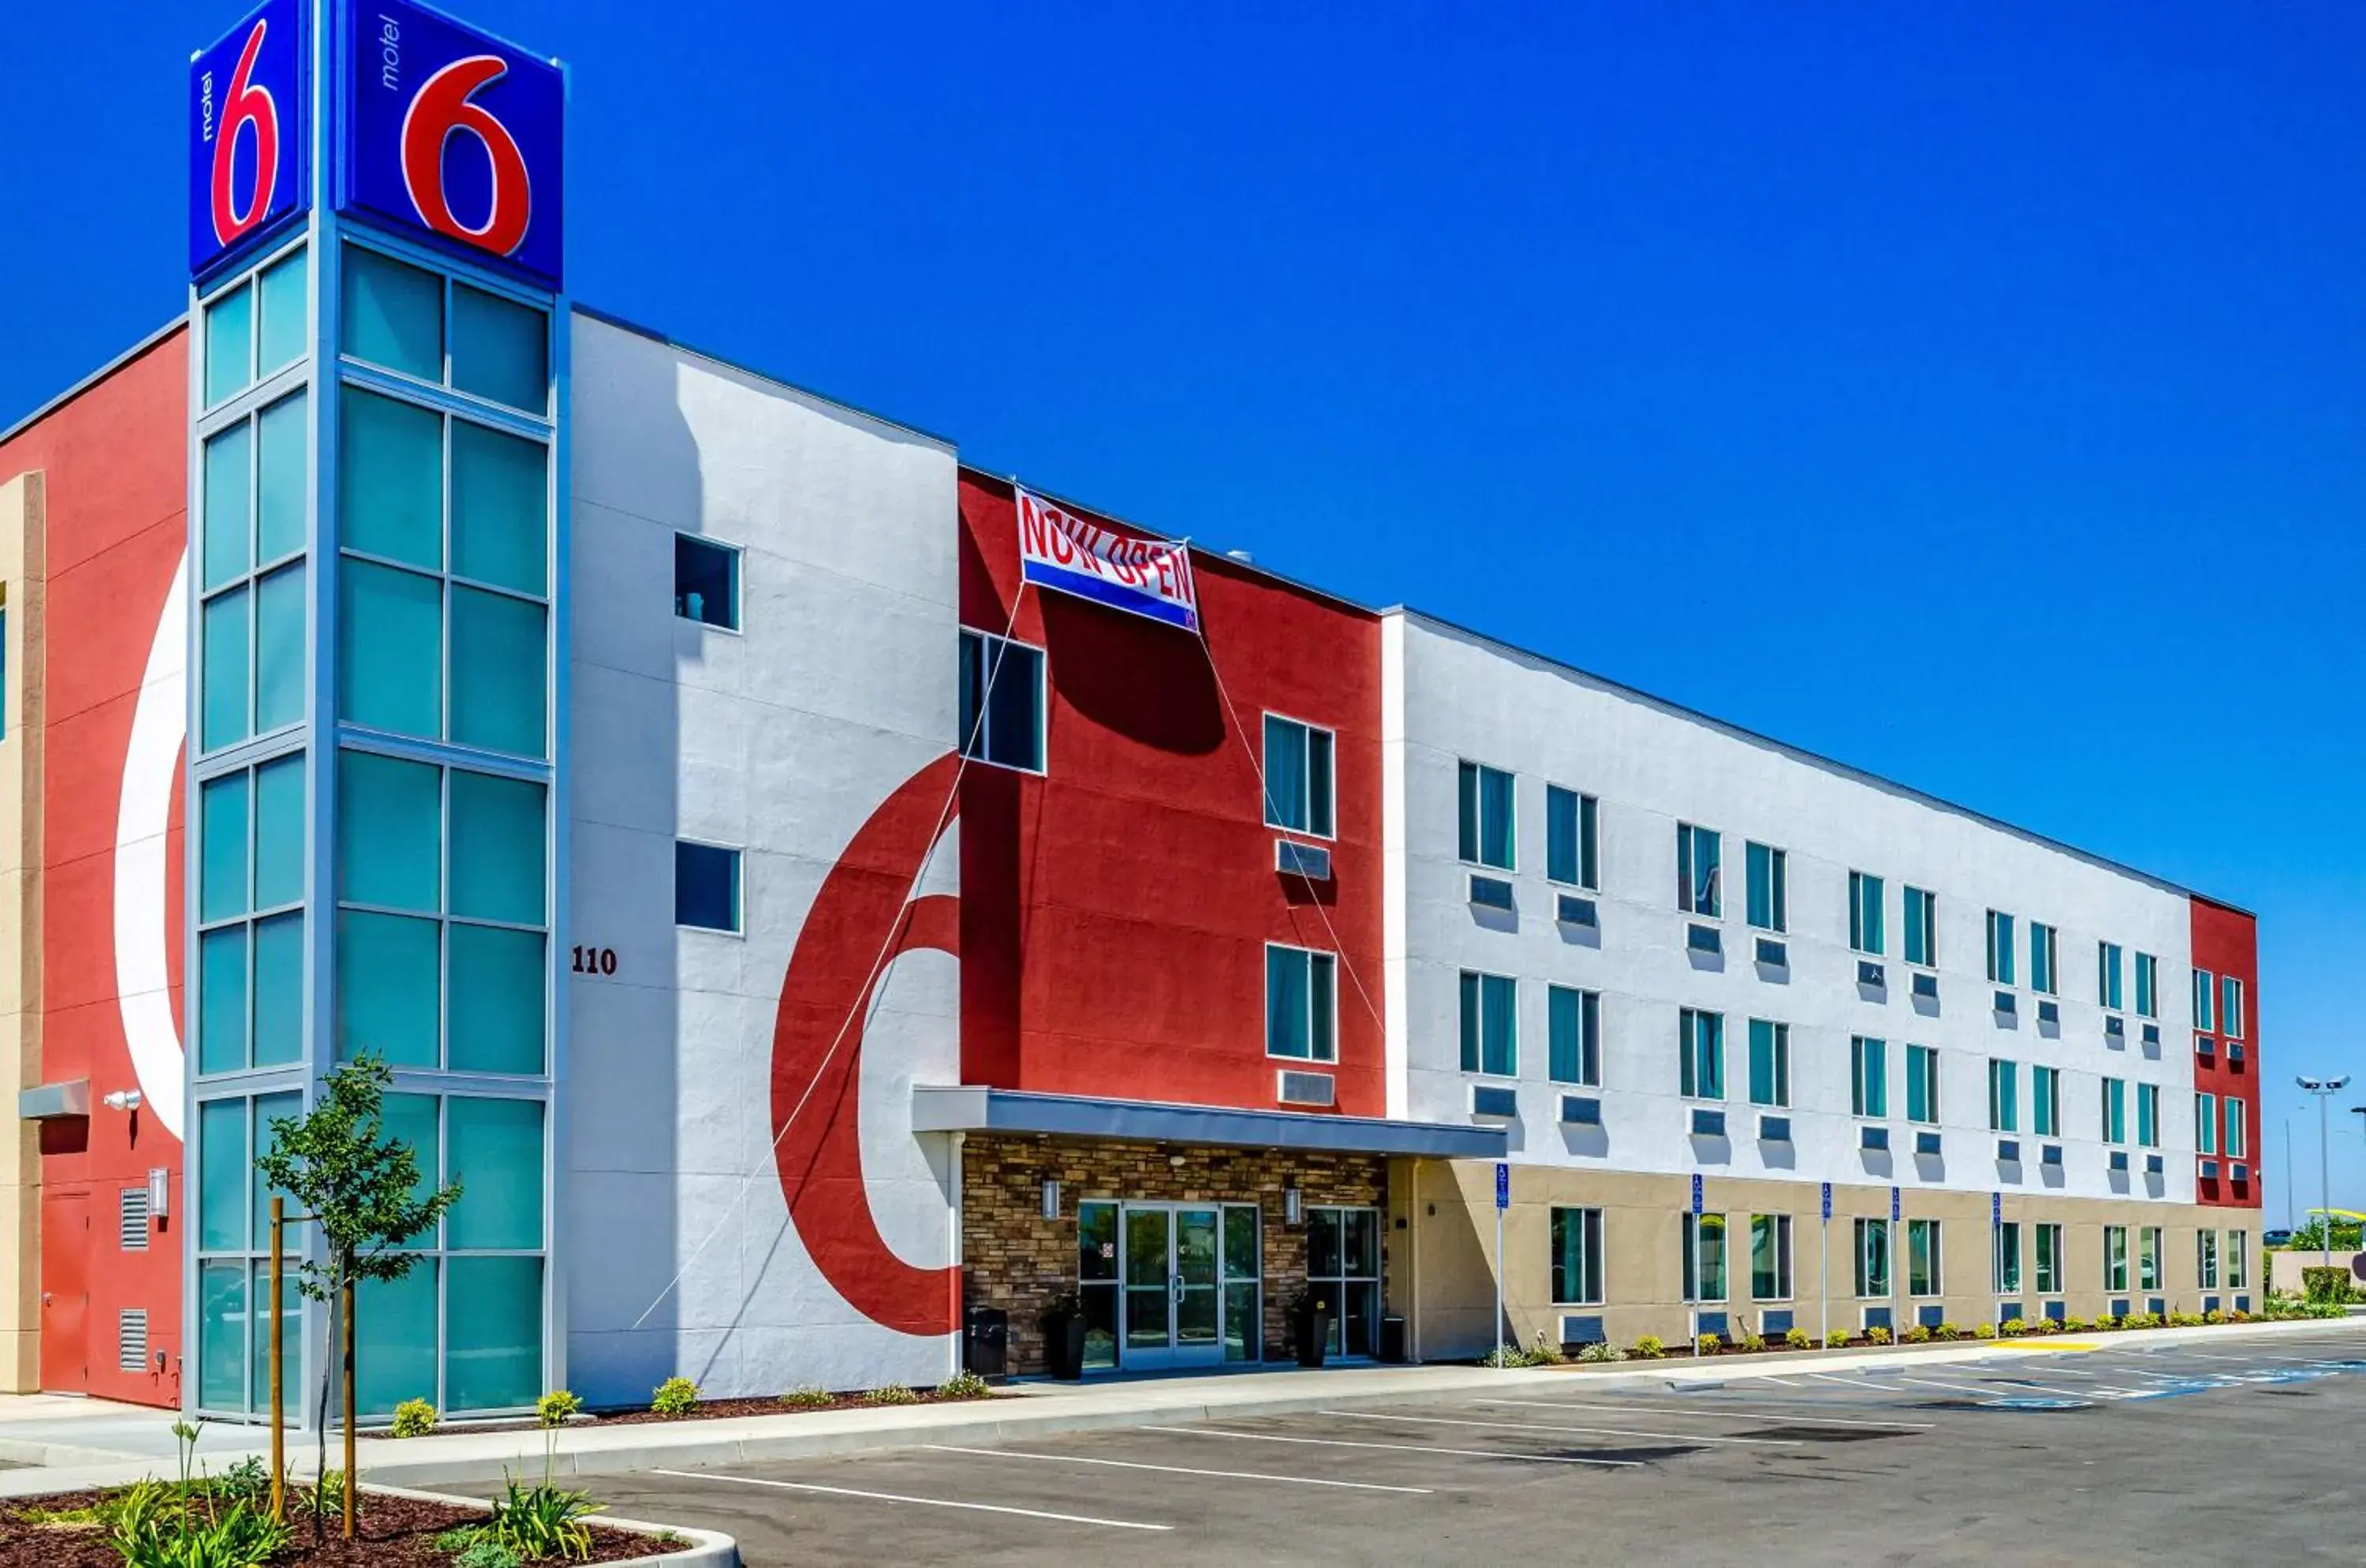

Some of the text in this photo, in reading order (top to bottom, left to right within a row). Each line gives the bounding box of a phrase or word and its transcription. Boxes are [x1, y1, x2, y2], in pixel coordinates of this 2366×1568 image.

[379, 13, 400, 91] motel
[202, 70, 212, 142] motel
[211, 18, 279, 248] 6
[401, 54, 532, 257] 6
[1021, 496, 1192, 604] NOW OPEN
[572, 945, 618, 976] 110
